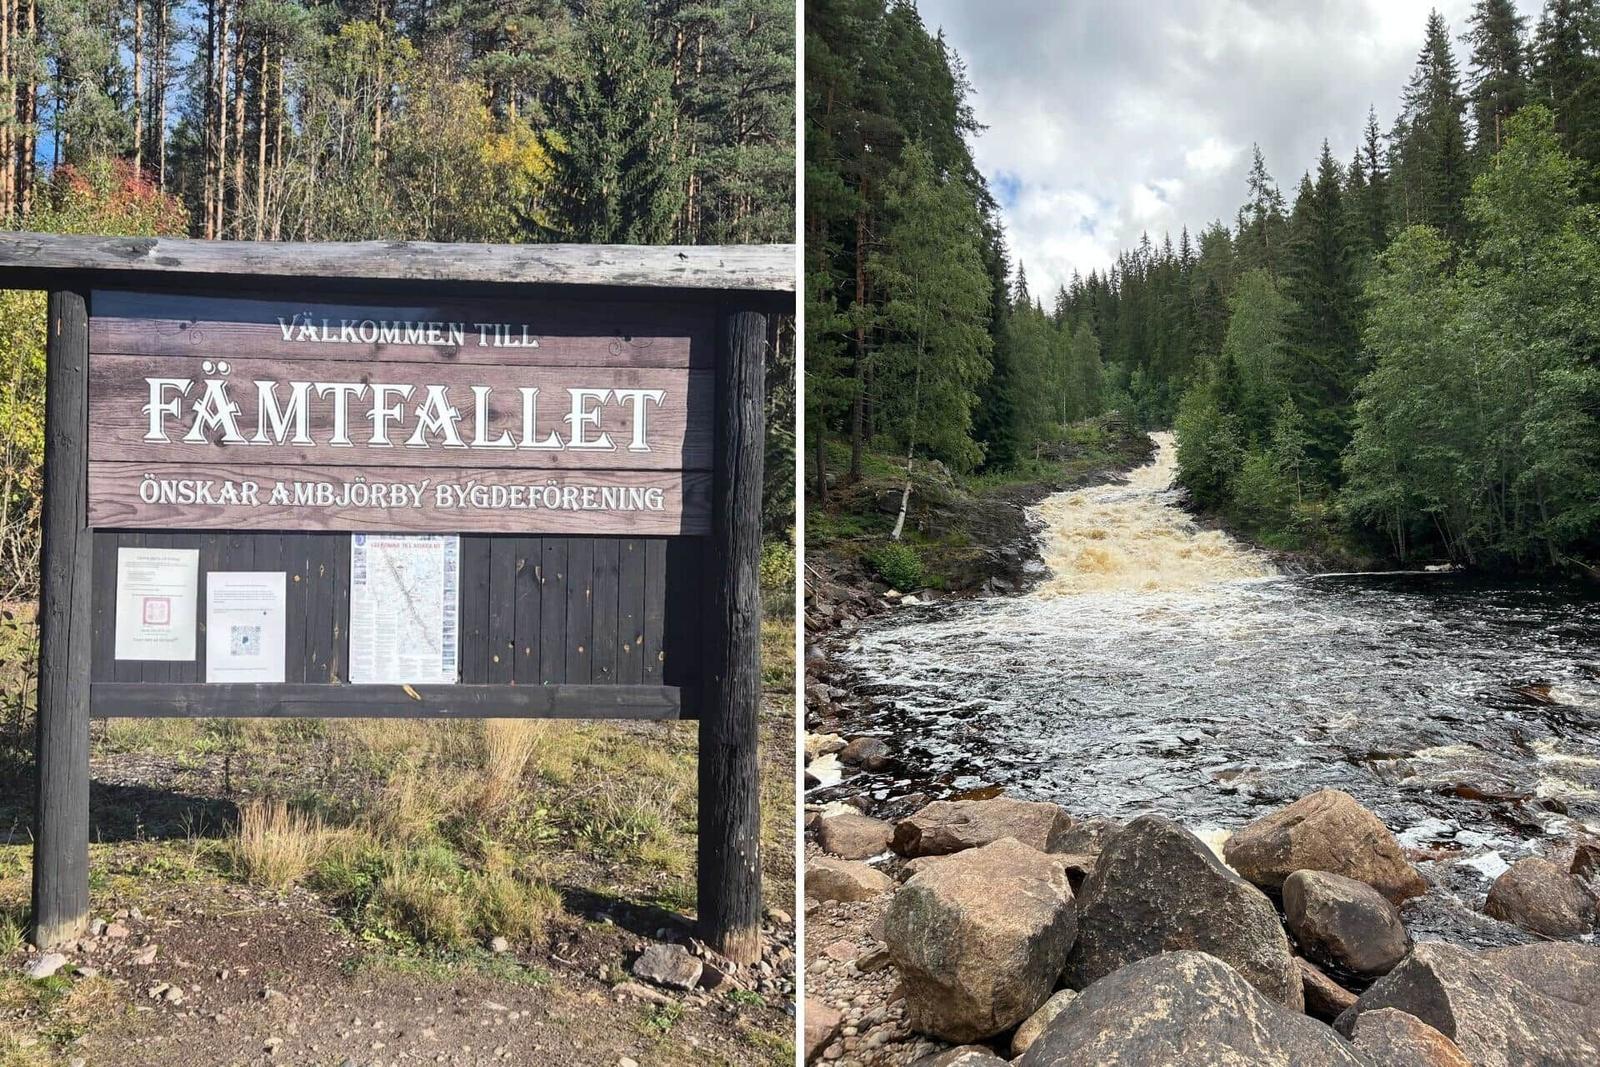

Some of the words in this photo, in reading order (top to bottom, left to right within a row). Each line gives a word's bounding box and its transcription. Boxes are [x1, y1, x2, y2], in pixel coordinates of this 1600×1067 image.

[279, 312, 465, 346] VÄLKOMMEN
[474, 323, 540, 348] TILL
[140, 361, 667, 453] FÄMTFALLET
[139, 474, 262, 506] ÖNSKAR
[268, 477, 430, 509] AMBJÖRBY
[434, 479, 666, 512] BYGDEFÖRENING
